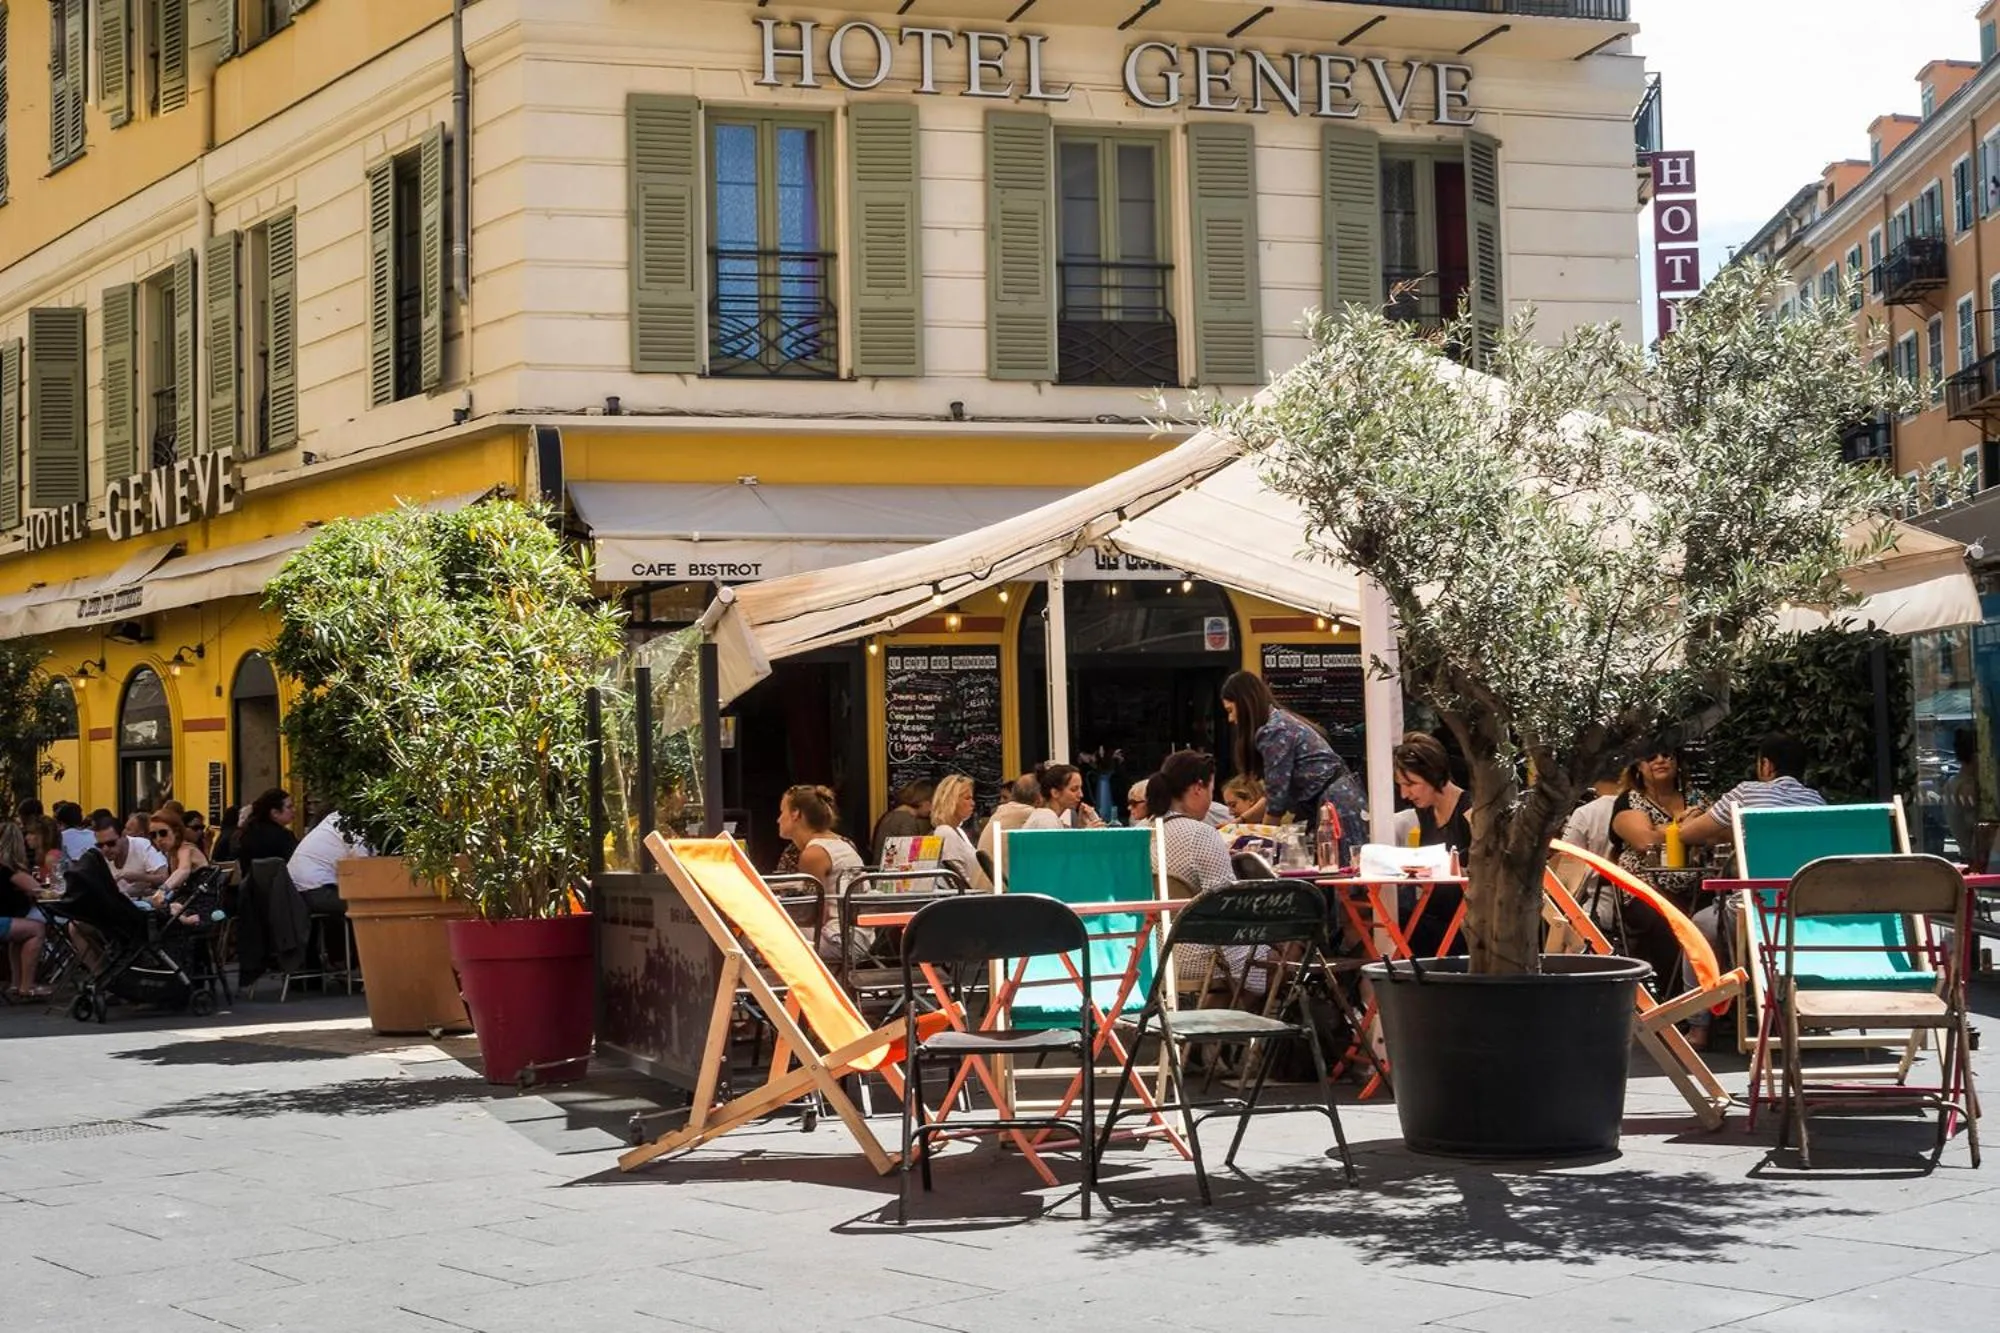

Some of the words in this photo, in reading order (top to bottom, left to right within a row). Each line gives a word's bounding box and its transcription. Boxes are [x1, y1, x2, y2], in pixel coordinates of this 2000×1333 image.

[753, 17, 1074, 102] HOTEL
[1122, 40, 1481, 127] GENEVE
[23, 502, 84, 552] HOTEL
[105, 445, 238, 541] GENEVE
[631, 563, 677, 576] CAFE
[688, 563, 762, 577] BISTROT
